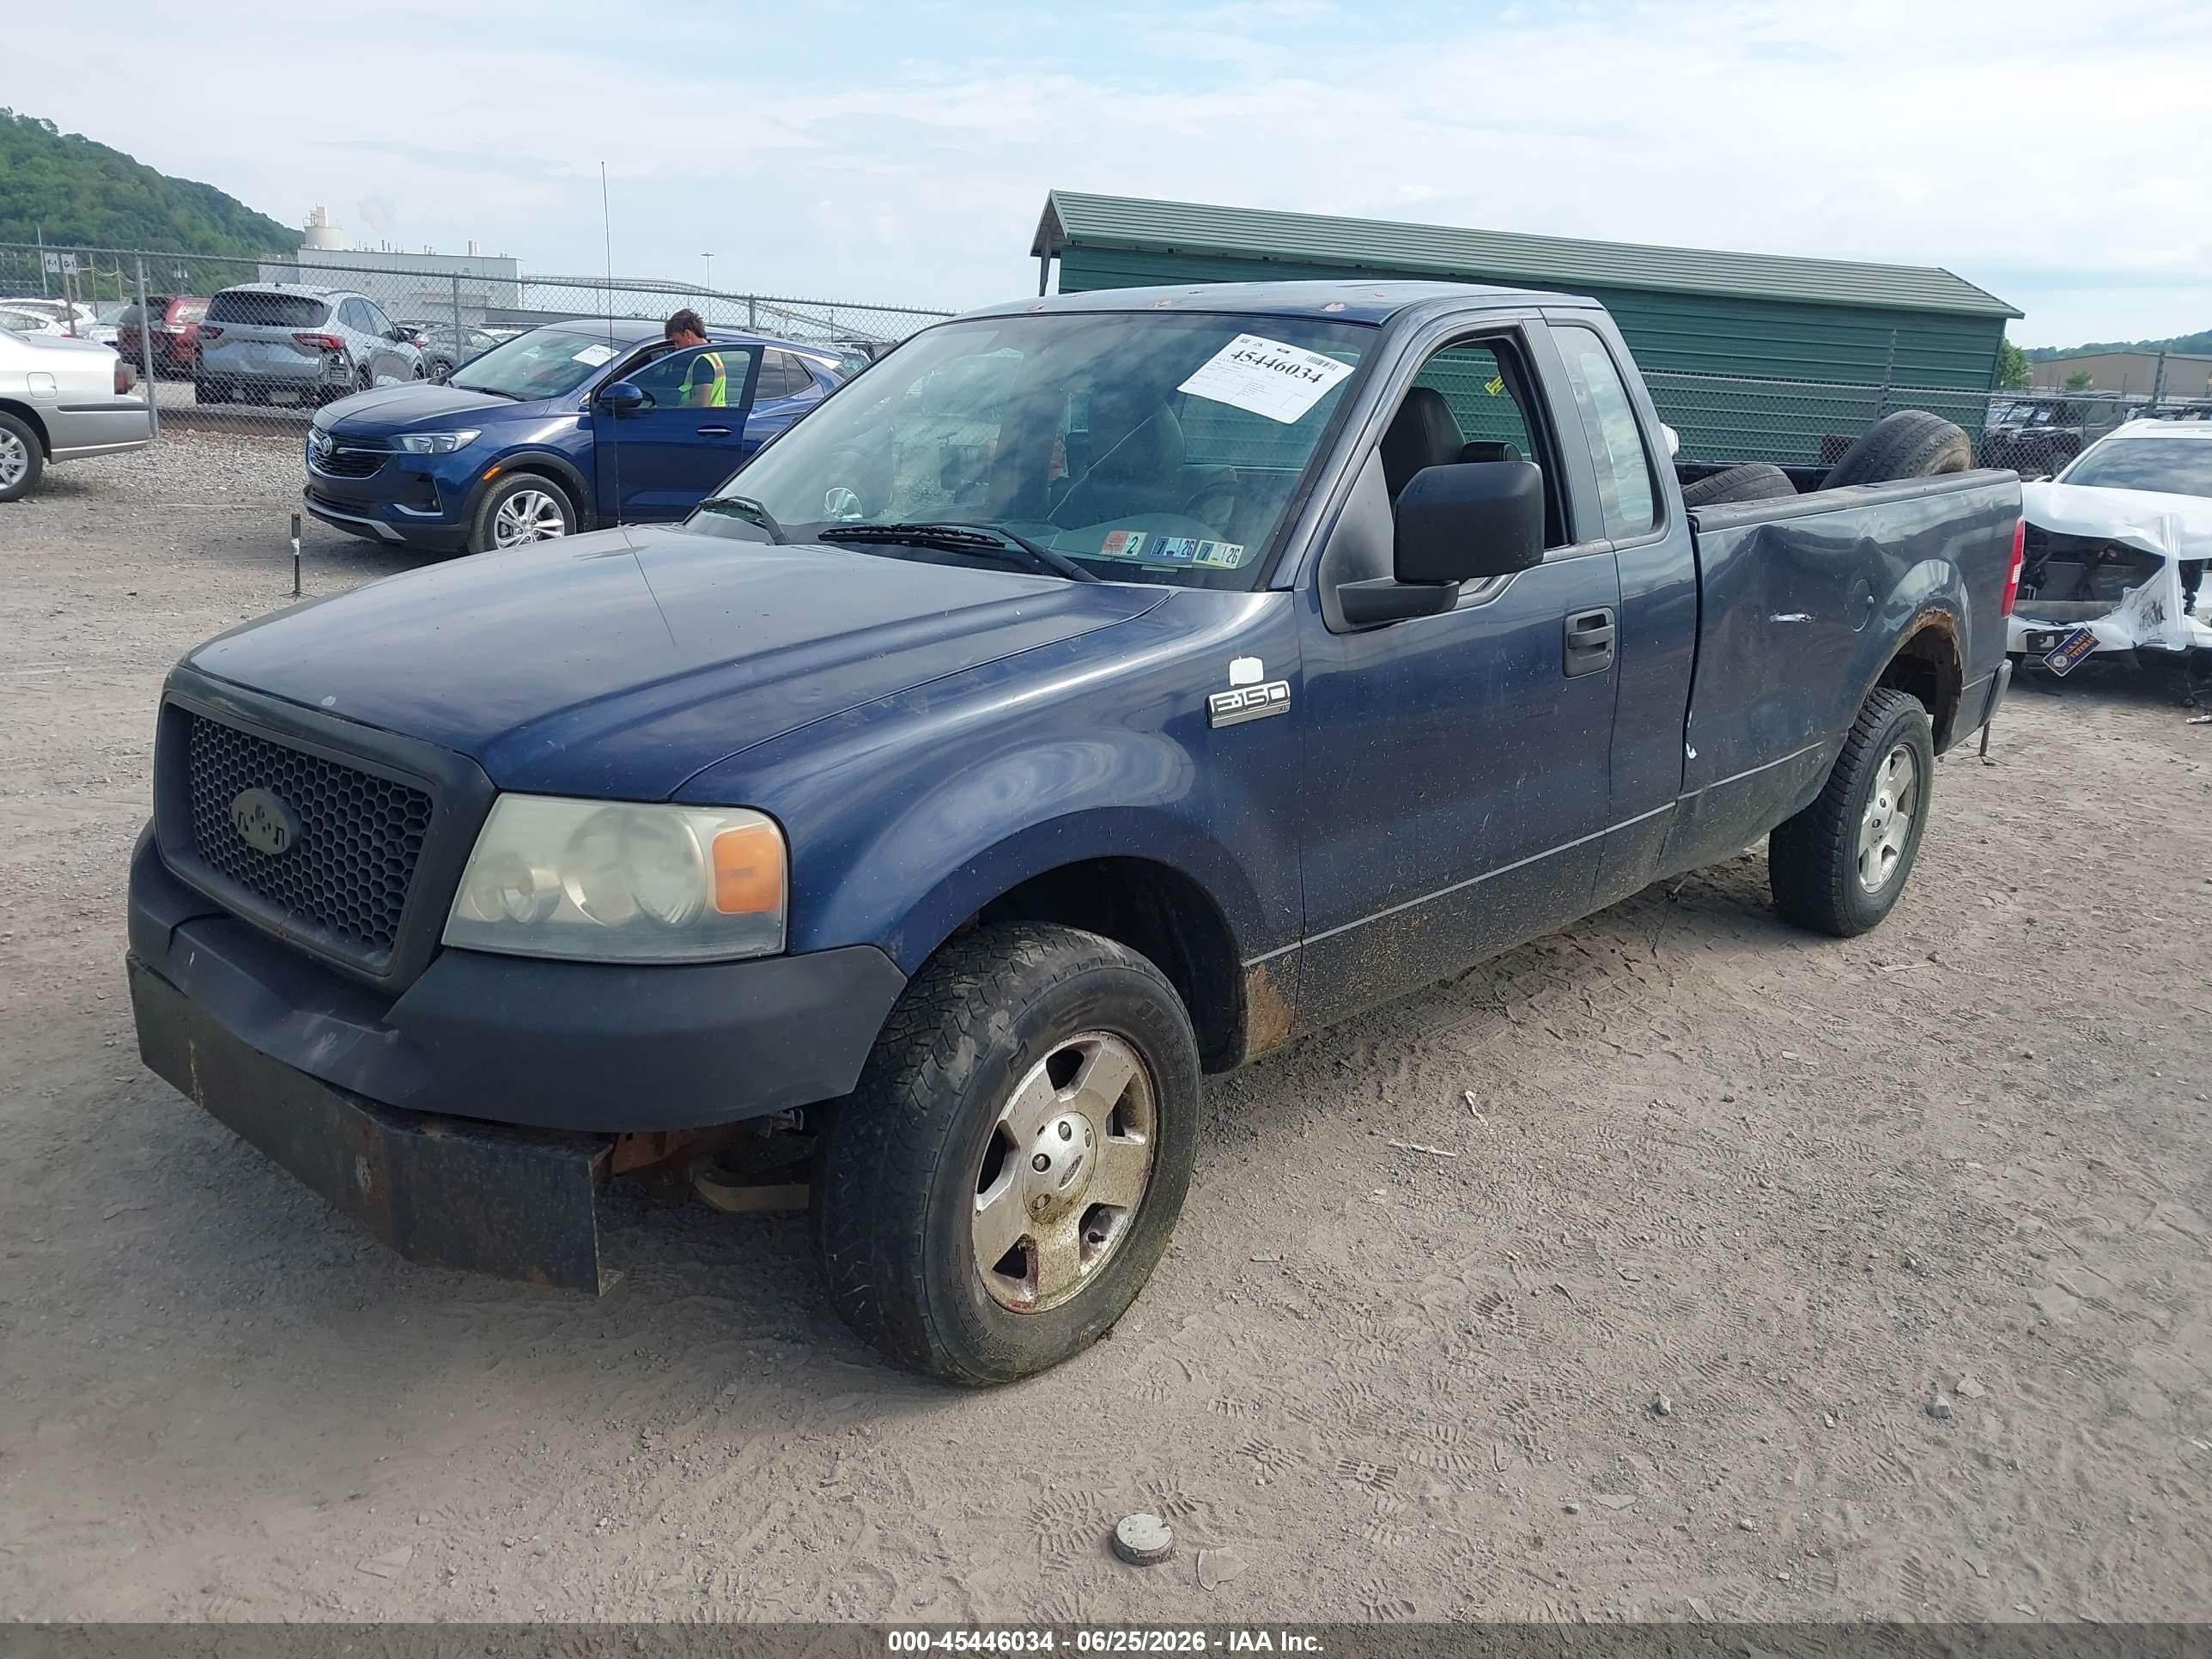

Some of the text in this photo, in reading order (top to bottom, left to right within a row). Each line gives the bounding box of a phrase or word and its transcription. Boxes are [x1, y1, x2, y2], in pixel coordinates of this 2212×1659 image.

[1231, 349, 1325, 384] 45446034
[1127, 536, 1139, 555] 2
[1157, 539, 1195, 556] 7 26
[1201, 545, 1241, 564] 7 26
